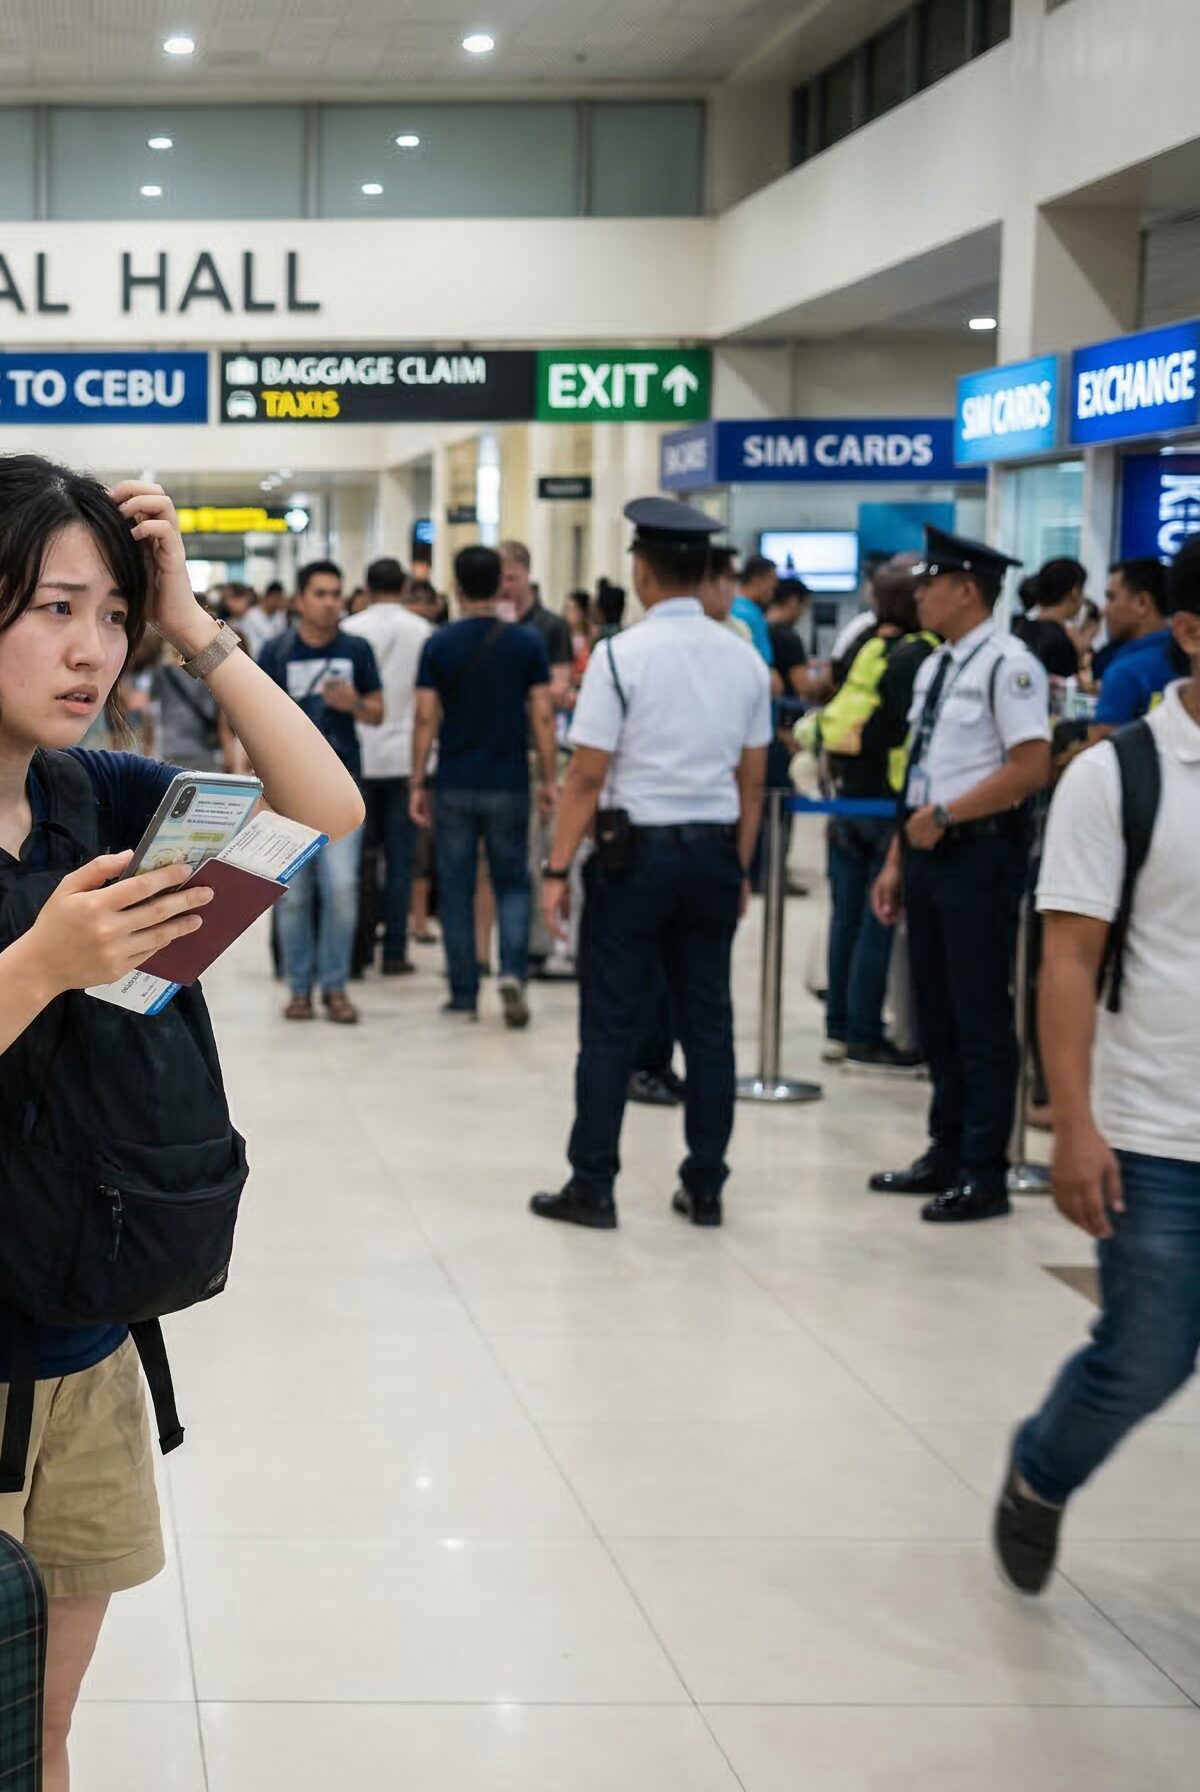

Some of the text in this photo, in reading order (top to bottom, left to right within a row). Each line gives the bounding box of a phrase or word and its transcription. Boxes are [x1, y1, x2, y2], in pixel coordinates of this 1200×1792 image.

[121, 250, 322, 315] HALL
[6, 370, 67, 407] TO
[74, 370, 186, 408] CEBU
[261, 356, 487, 385] BAGGAGE CLAIM
[548, 363, 659, 409] EXIT
[1076, 349, 1197, 420] EXCHANGE
[260, 390, 340, 418] TAXIS
[743, 434, 809, 468] SIM
[814, 433, 934, 467] CARDS
